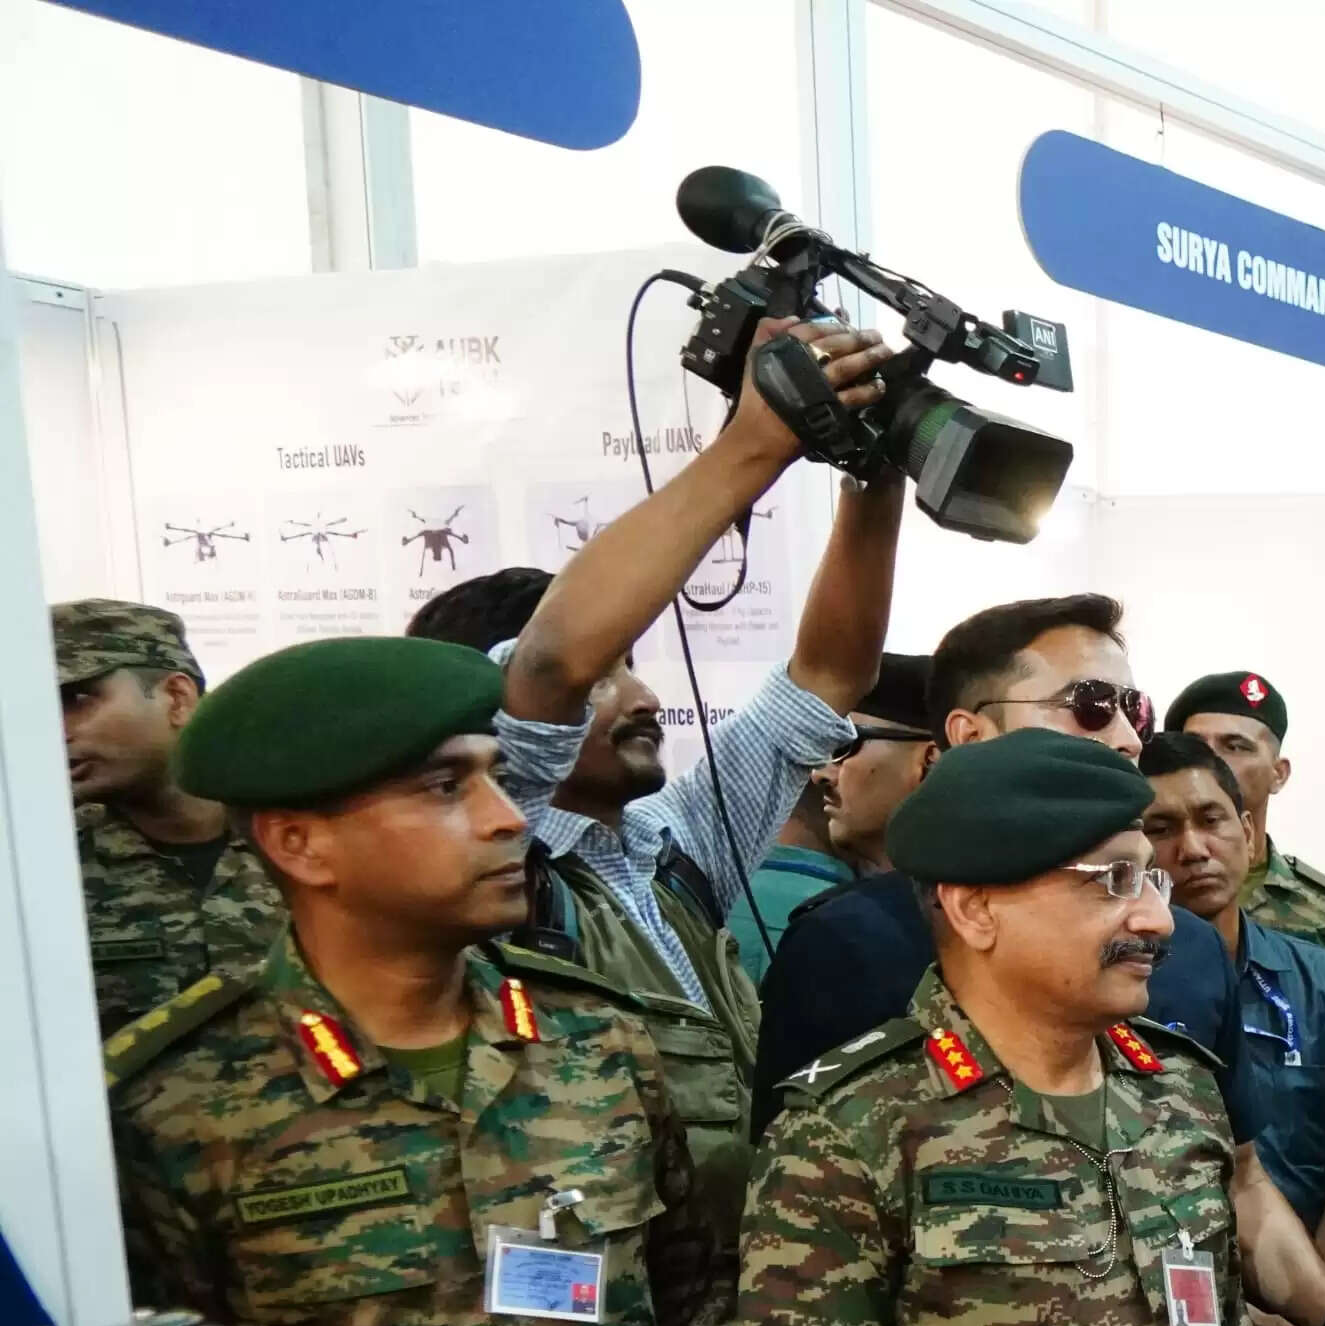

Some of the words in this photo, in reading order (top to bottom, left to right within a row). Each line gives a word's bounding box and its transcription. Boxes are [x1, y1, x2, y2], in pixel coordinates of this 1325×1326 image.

[1157, 222, 1232, 284] SURYA
[1035, 326, 1056, 346] ANI
[276, 444, 330, 469] Tactical
[333, 443, 366, 467] UAVs
[602, 428, 661, 463] Paylad
[665, 426, 703, 454] UAVs
[684, 582, 725, 597] straHaul
[942, 1181, 957, 1195] S
[961, 1180, 976, 1194] S
